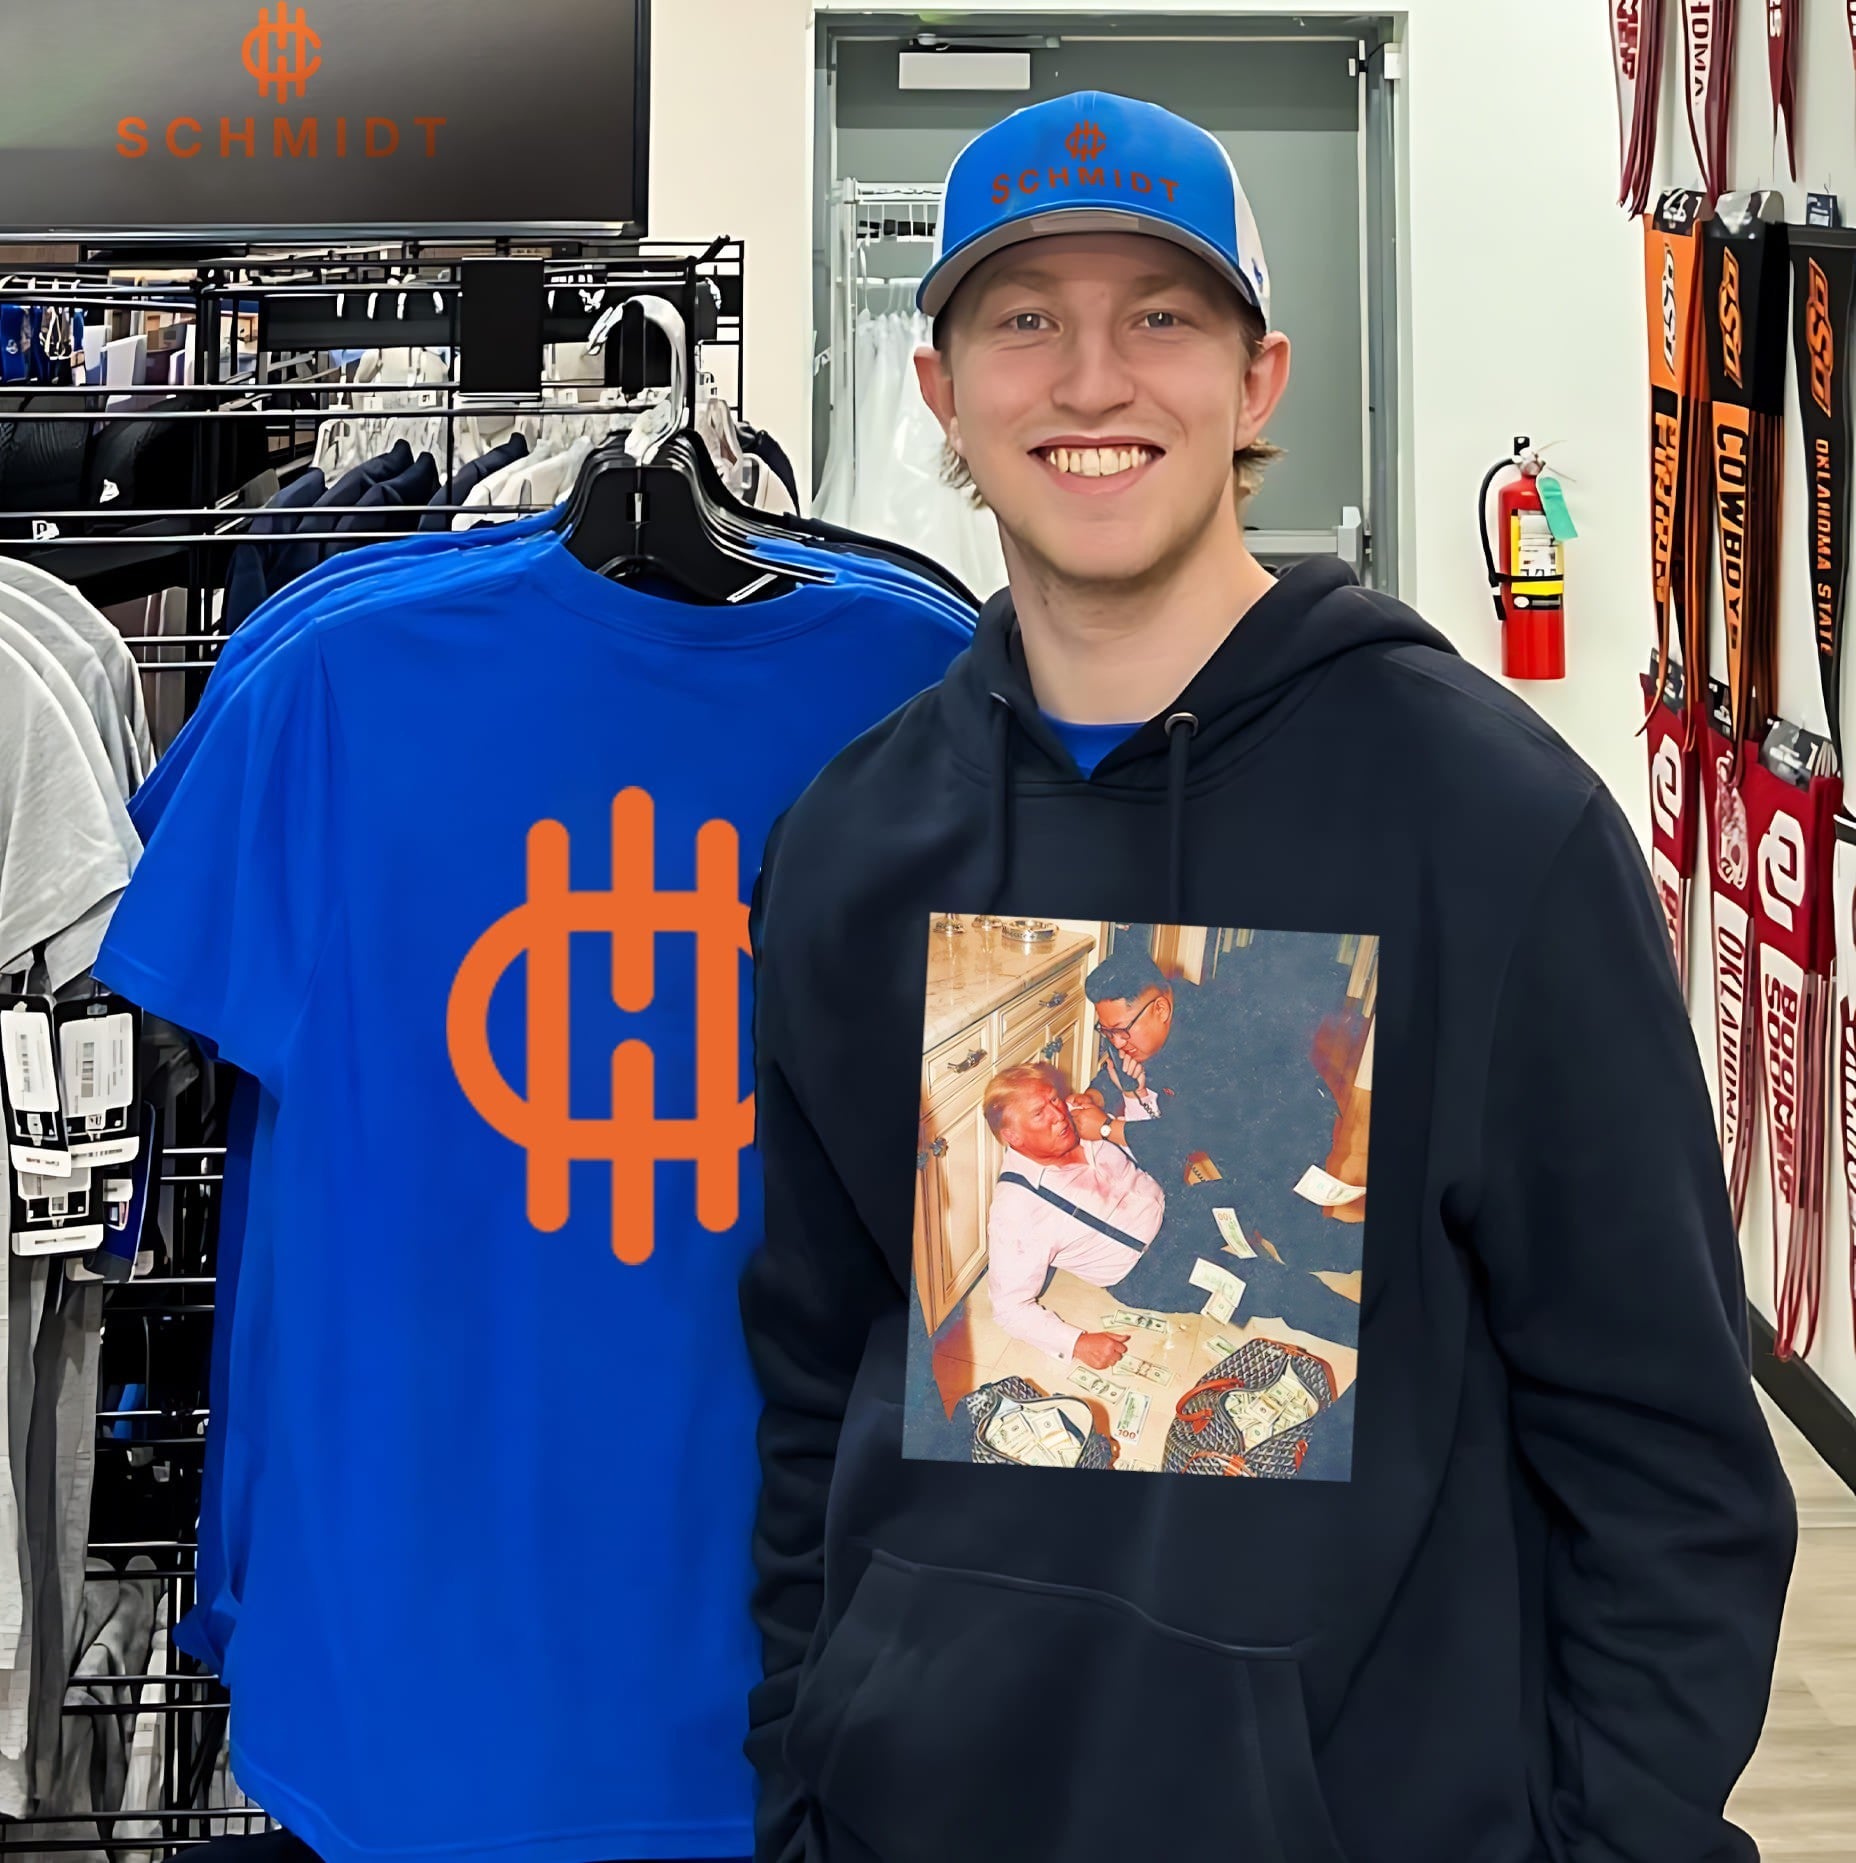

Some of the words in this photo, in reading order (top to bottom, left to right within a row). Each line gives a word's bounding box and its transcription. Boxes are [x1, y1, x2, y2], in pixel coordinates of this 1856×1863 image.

[115, 116, 448, 159] SCHMIDT
[991, 166, 1179, 205] SCHMIDT
[1815, 438, 1832, 570] OKLAHOMA
[1118, 1429, 1136, 1439] 100
